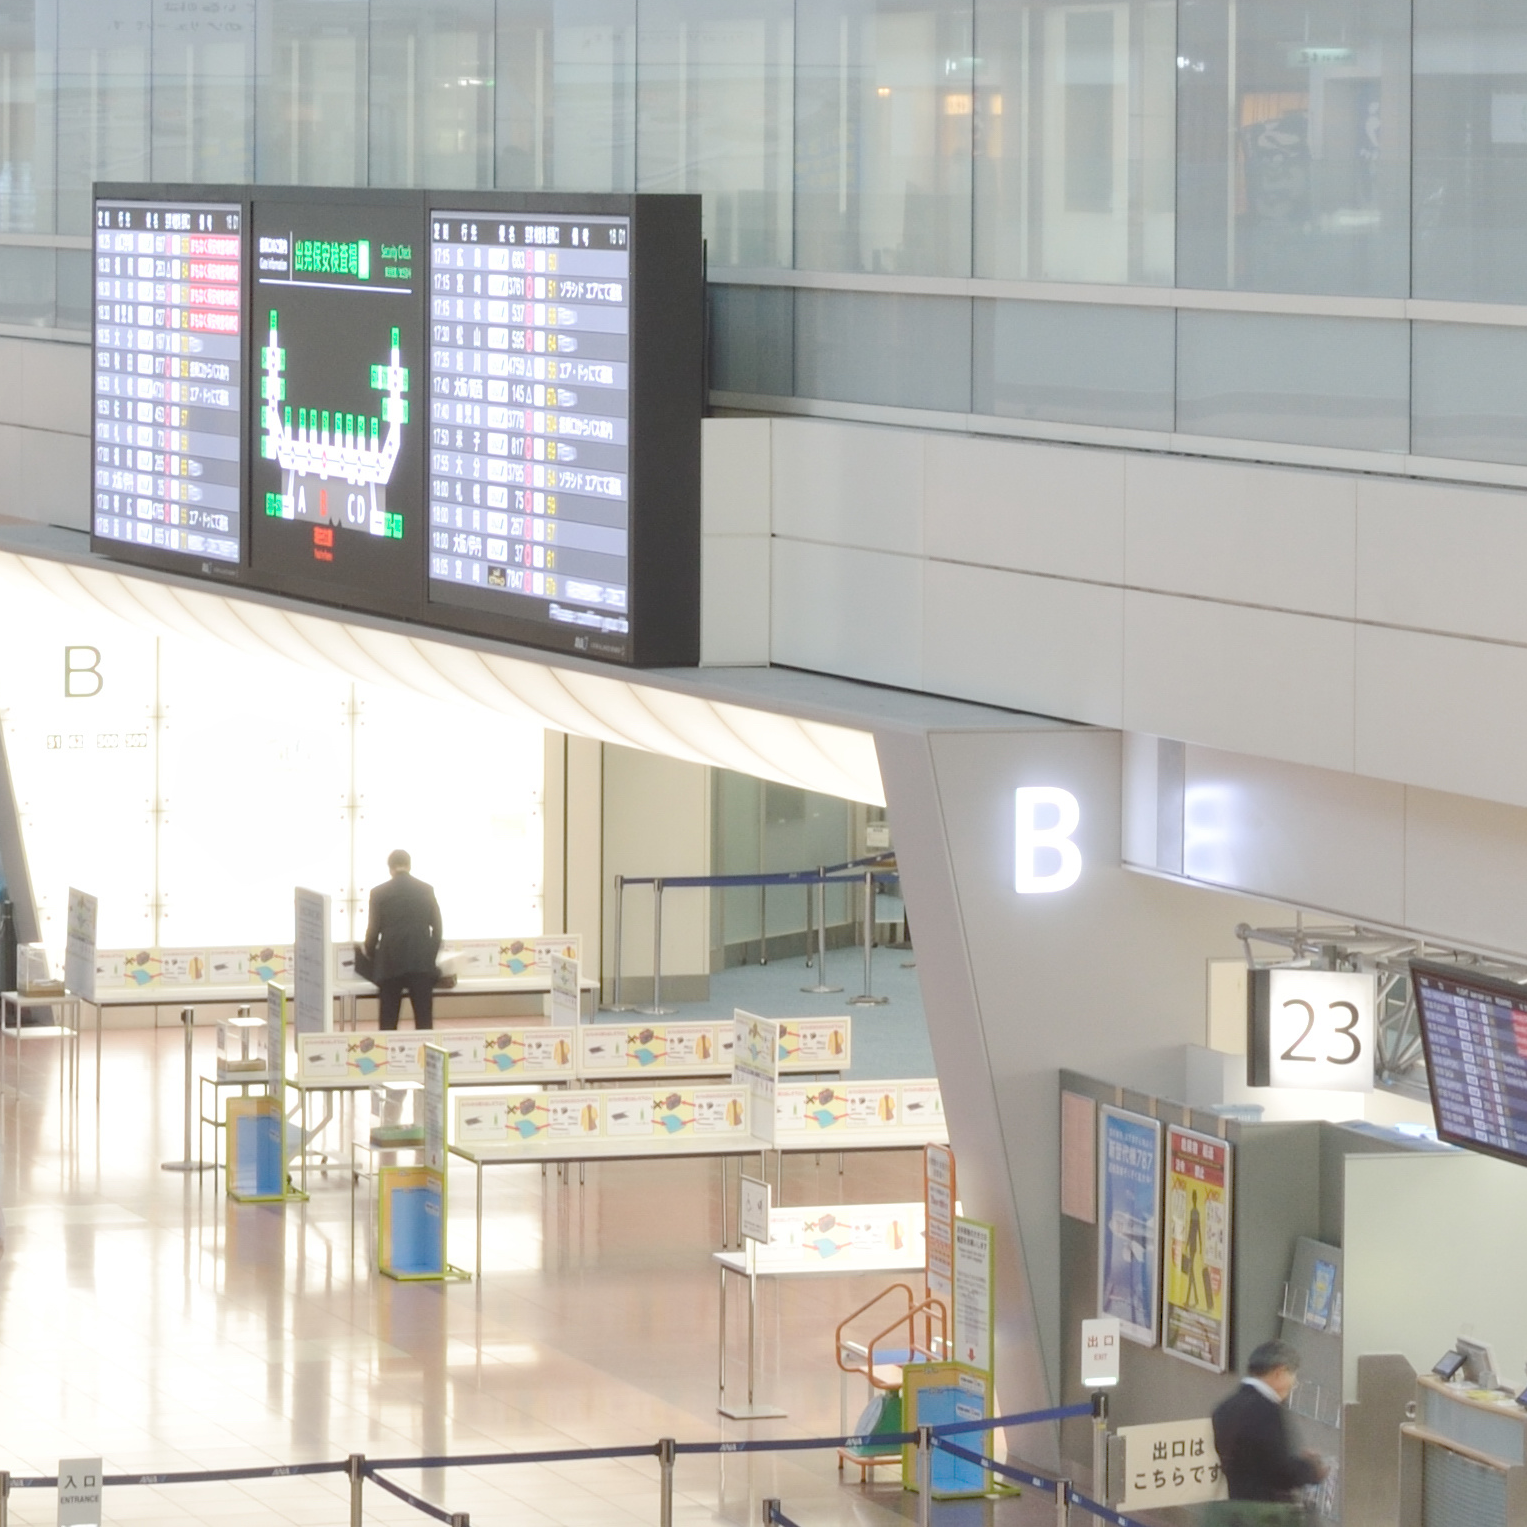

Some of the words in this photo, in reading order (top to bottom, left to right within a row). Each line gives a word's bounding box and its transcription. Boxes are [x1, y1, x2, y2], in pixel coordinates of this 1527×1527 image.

[298, 485, 306, 514] A
[347, 493, 355, 523] C
[357, 495, 365, 524] D
[64, 644, 104, 698] B
[1015, 786, 1083, 894] B
[1280, 998, 1362, 1067] 23
[1087, 1334, 1115, 1348] 出口
[1093, 1353, 1108, 1361] EXIT
[1152, 1437, 1205, 1461] 出口は
[64, 1474, 98, 1490] 入口
[1134, 1462, 1222, 1490] こちらです
[60, 1494, 101, 1505] ENTRANCE
